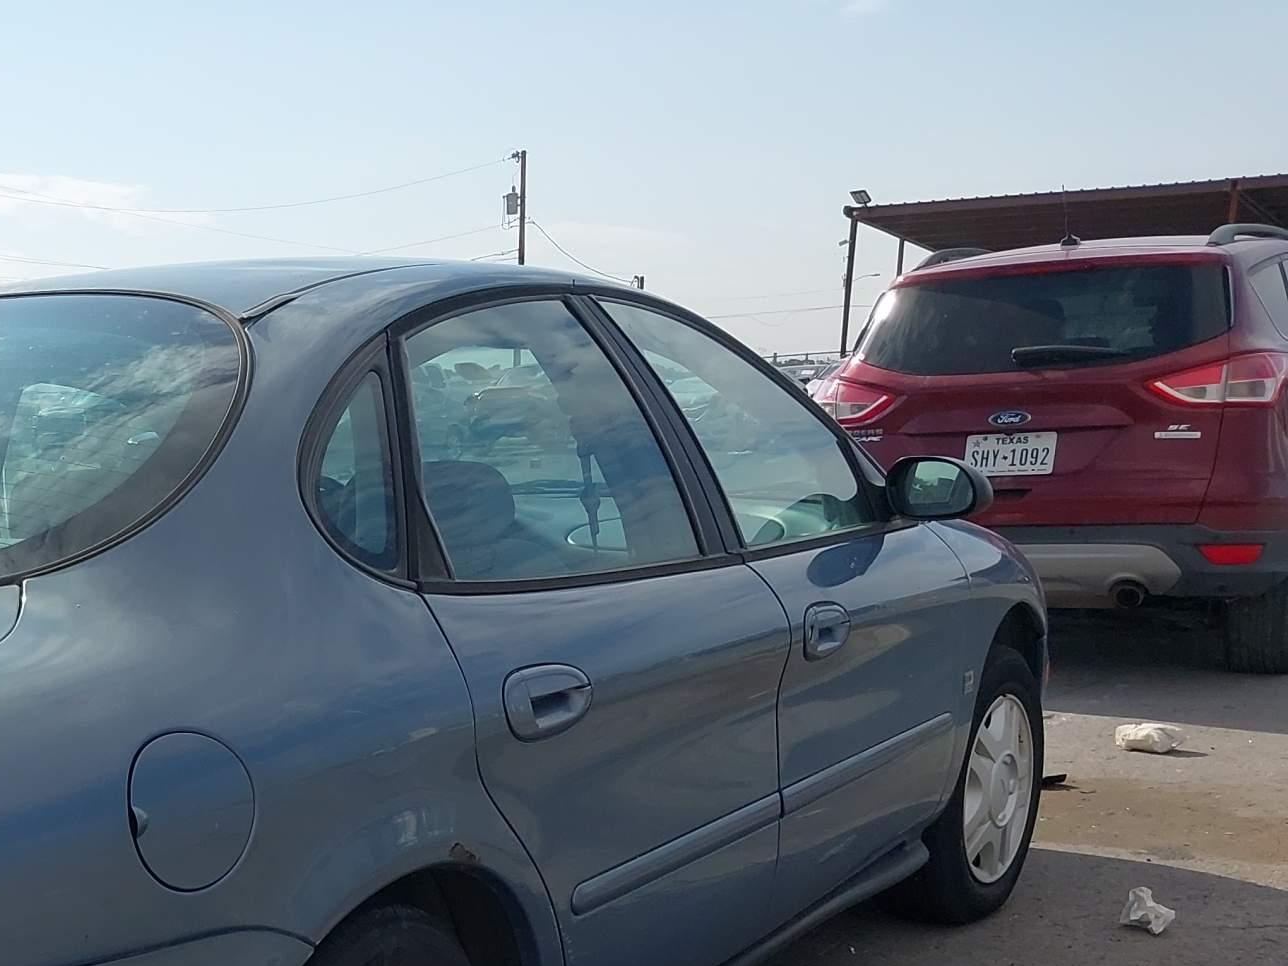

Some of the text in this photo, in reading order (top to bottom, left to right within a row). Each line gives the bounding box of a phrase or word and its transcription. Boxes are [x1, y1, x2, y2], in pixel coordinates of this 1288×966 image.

[995, 436, 1029, 446] TEXAS
[970, 447, 1050, 468] SHY 1092
